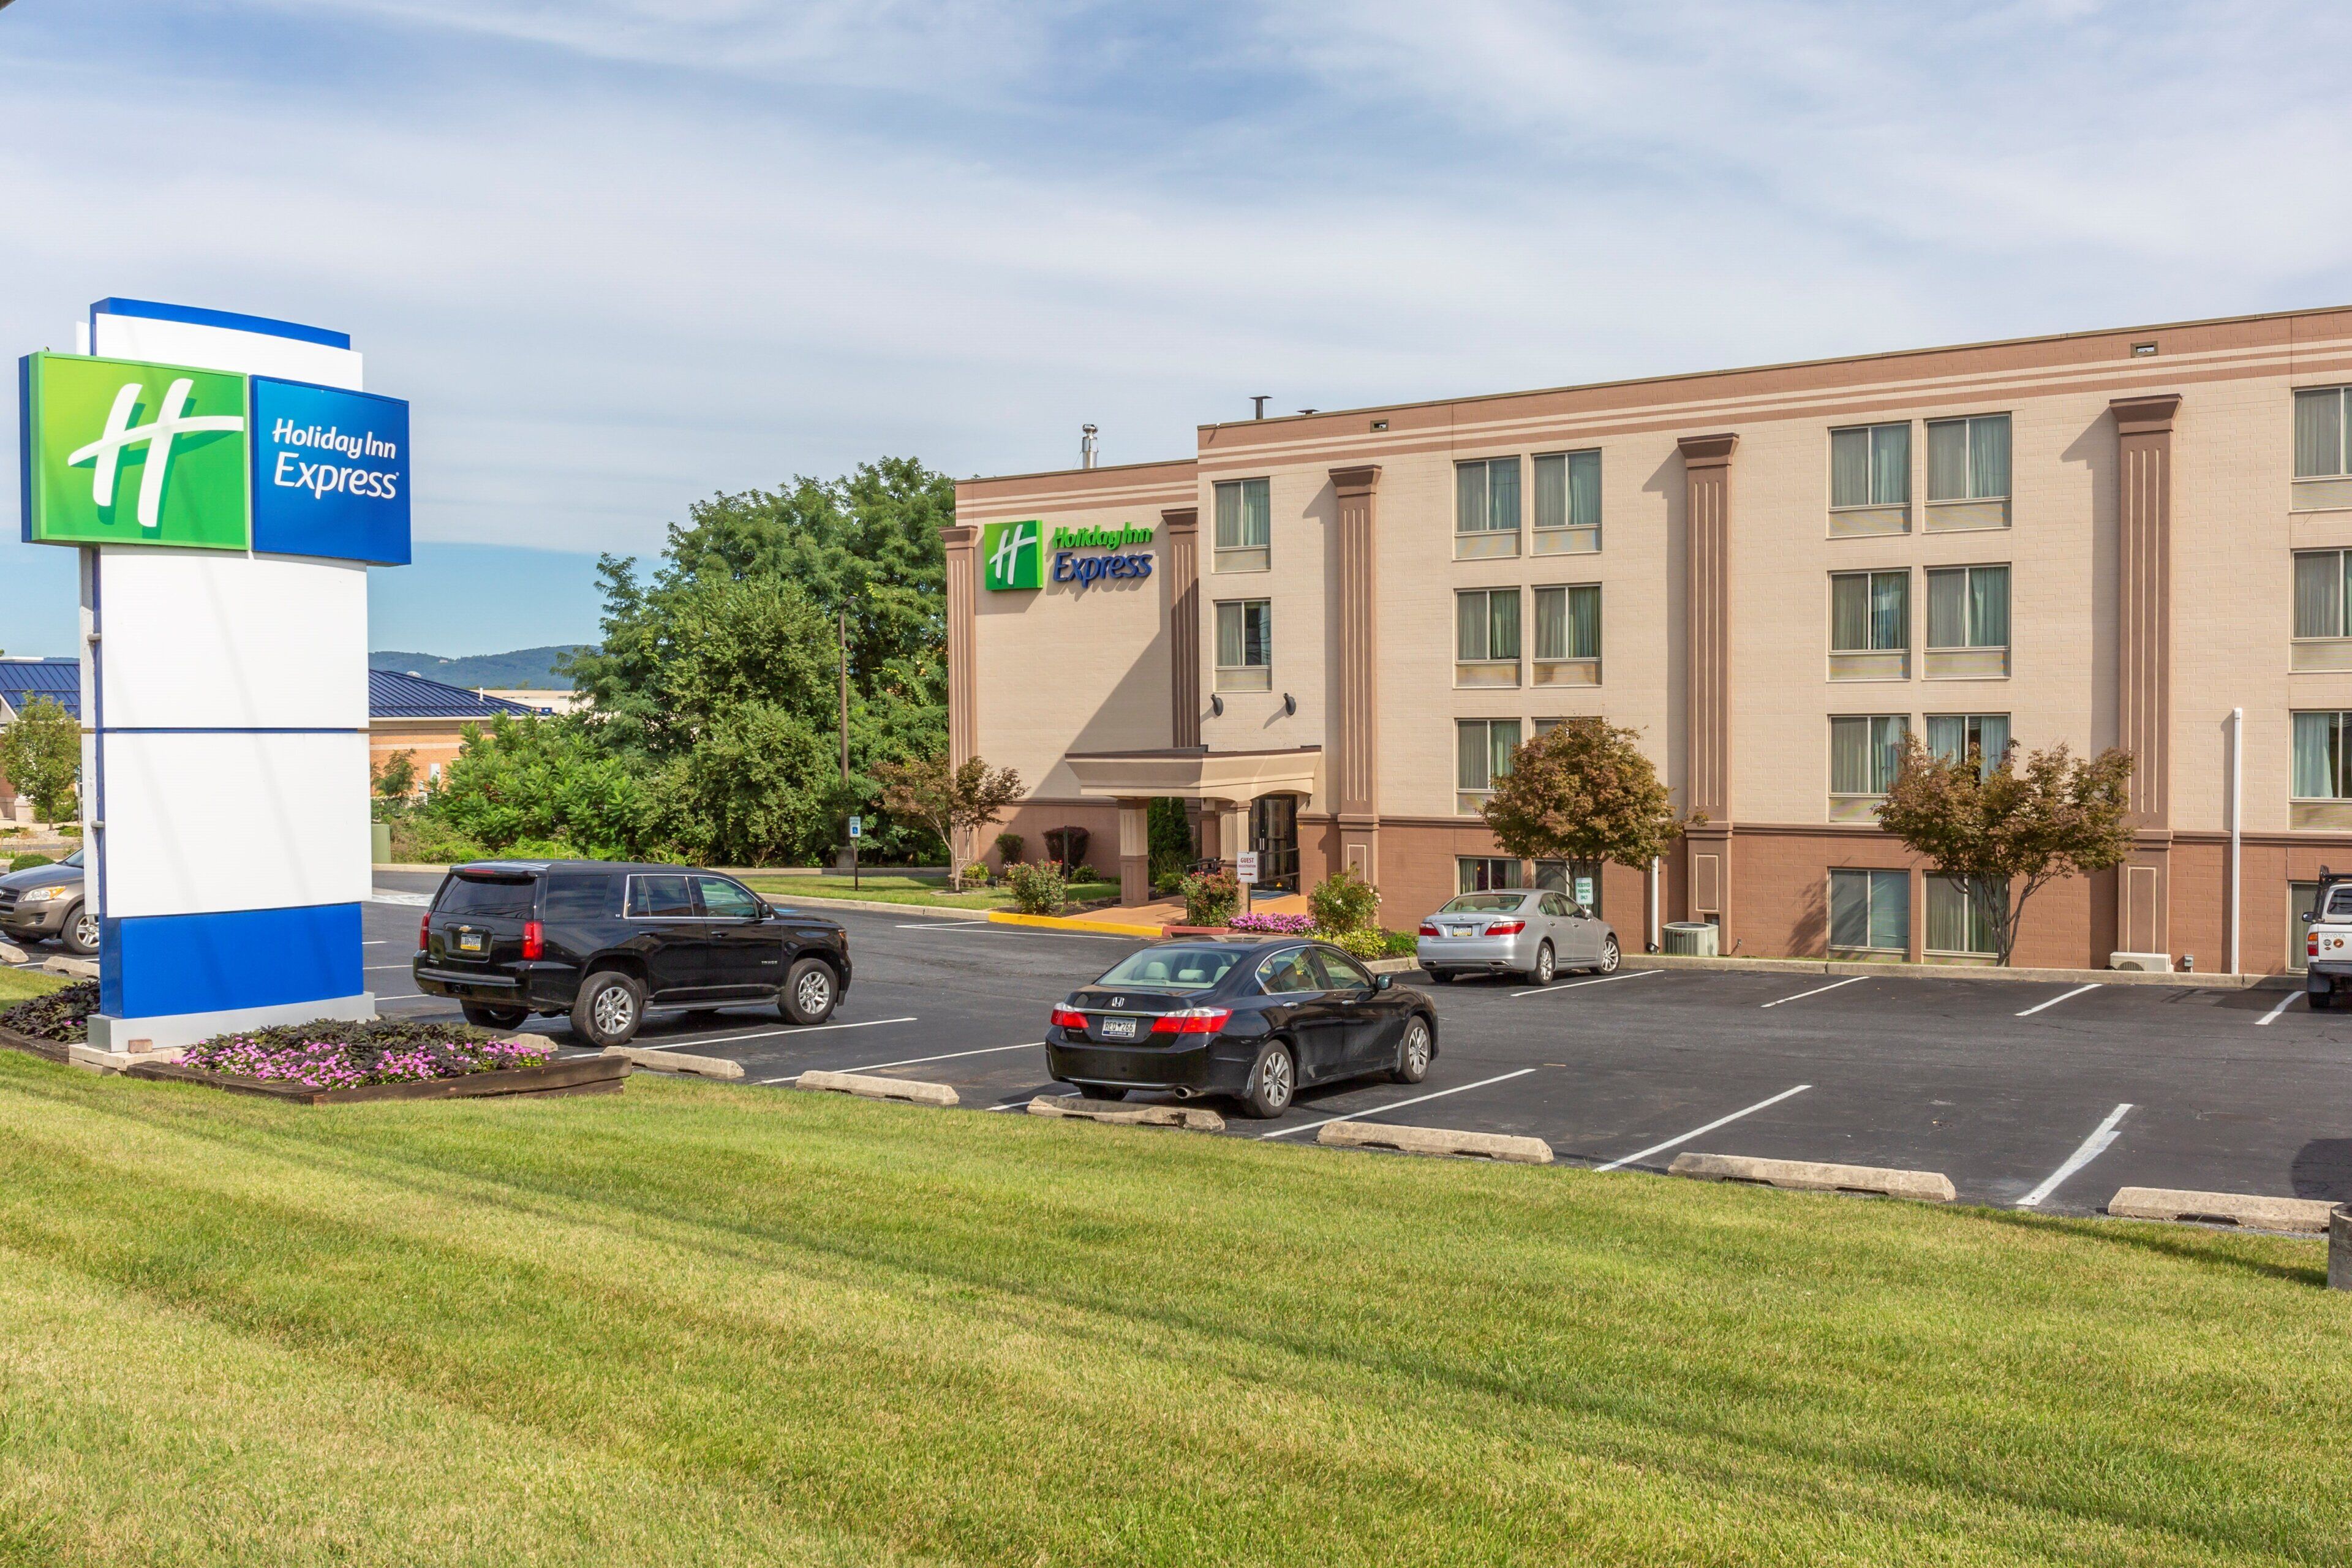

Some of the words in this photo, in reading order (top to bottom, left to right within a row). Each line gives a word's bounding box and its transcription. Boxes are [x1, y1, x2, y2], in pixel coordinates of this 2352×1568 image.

[272, 418, 363, 459] Holiday
[365, 431, 396, 459] Inn
[274, 451, 397, 499] Express
[1052, 525, 1122, 550] Holiday
[1122, 522, 1153, 544] Inn
[1053, 552, 1153, 588] Express
